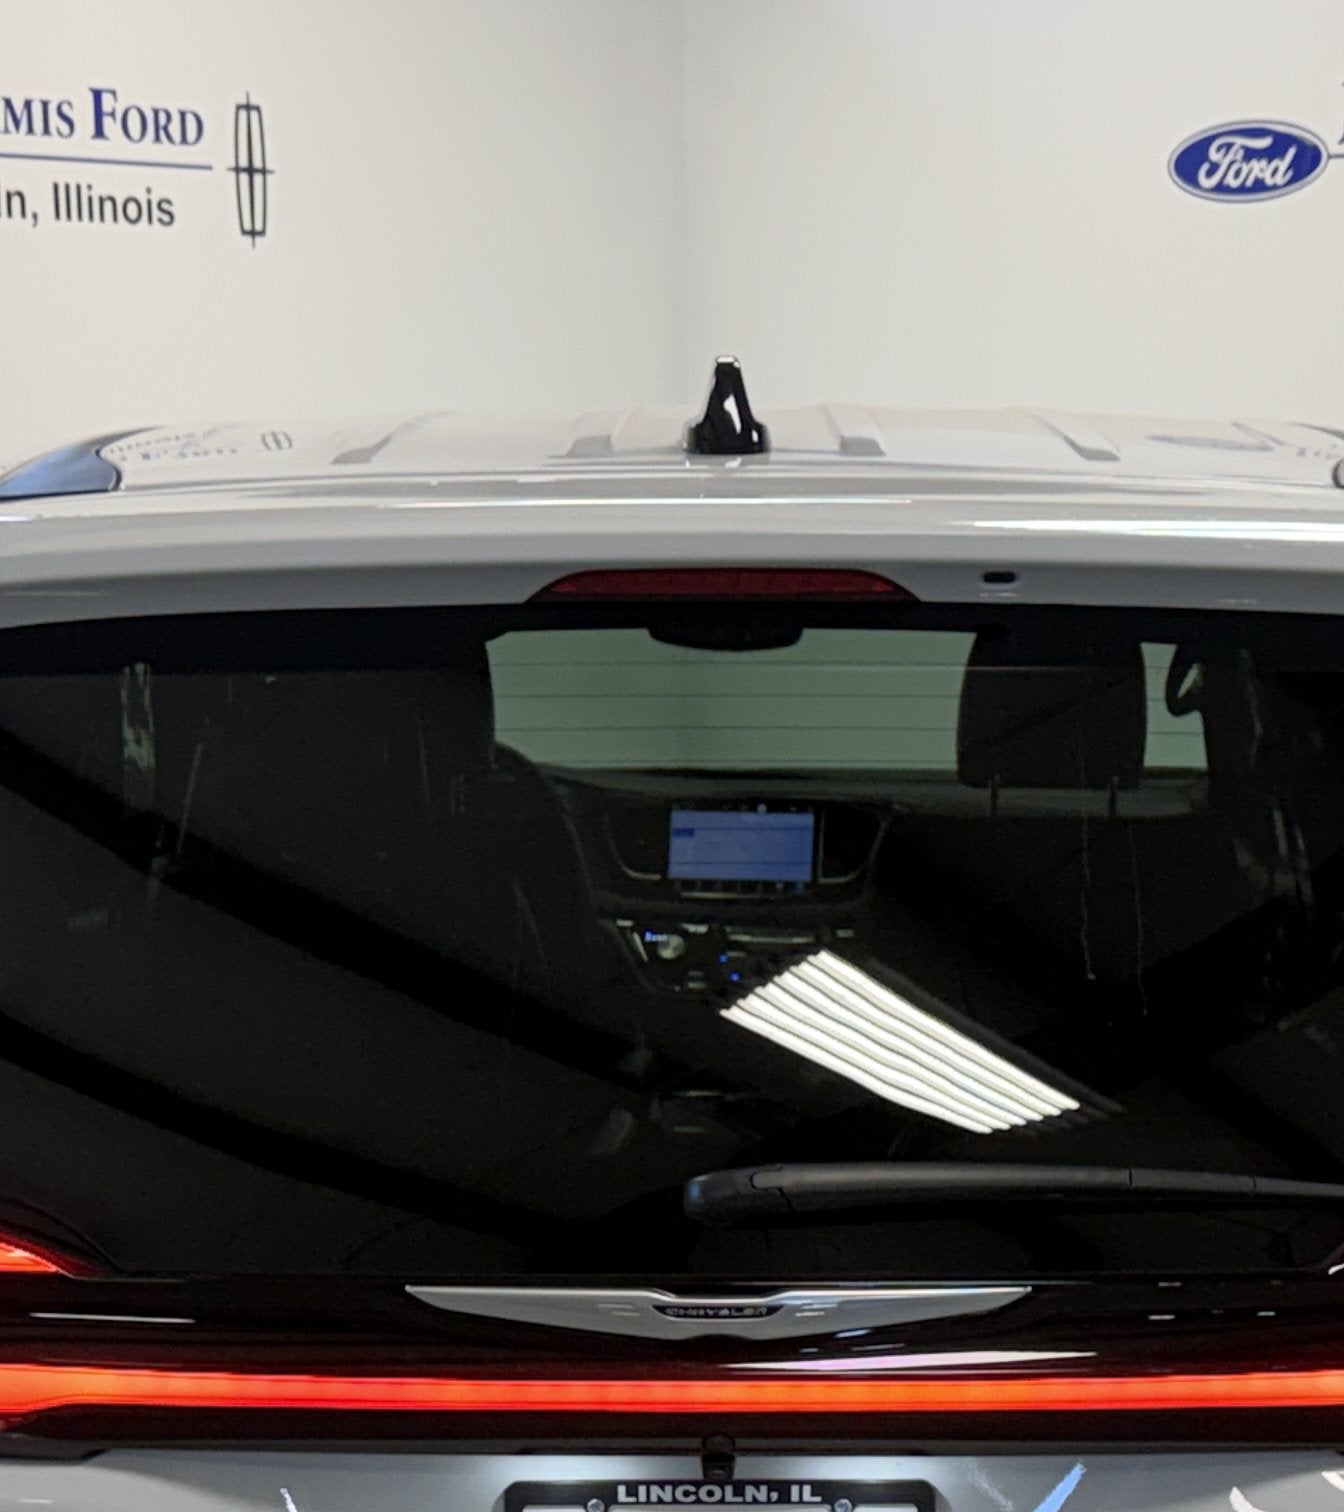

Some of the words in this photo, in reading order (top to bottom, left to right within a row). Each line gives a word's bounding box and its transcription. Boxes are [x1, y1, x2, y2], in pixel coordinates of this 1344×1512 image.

[89, 88, 205, 147] FORD
[1197, 135, 1293, 190] Ford
[53, 182, 175, 227] Illinois
[616, 1485, 779, 1503] LINCOLN,
[790, 1485, 822, 1502] IL
